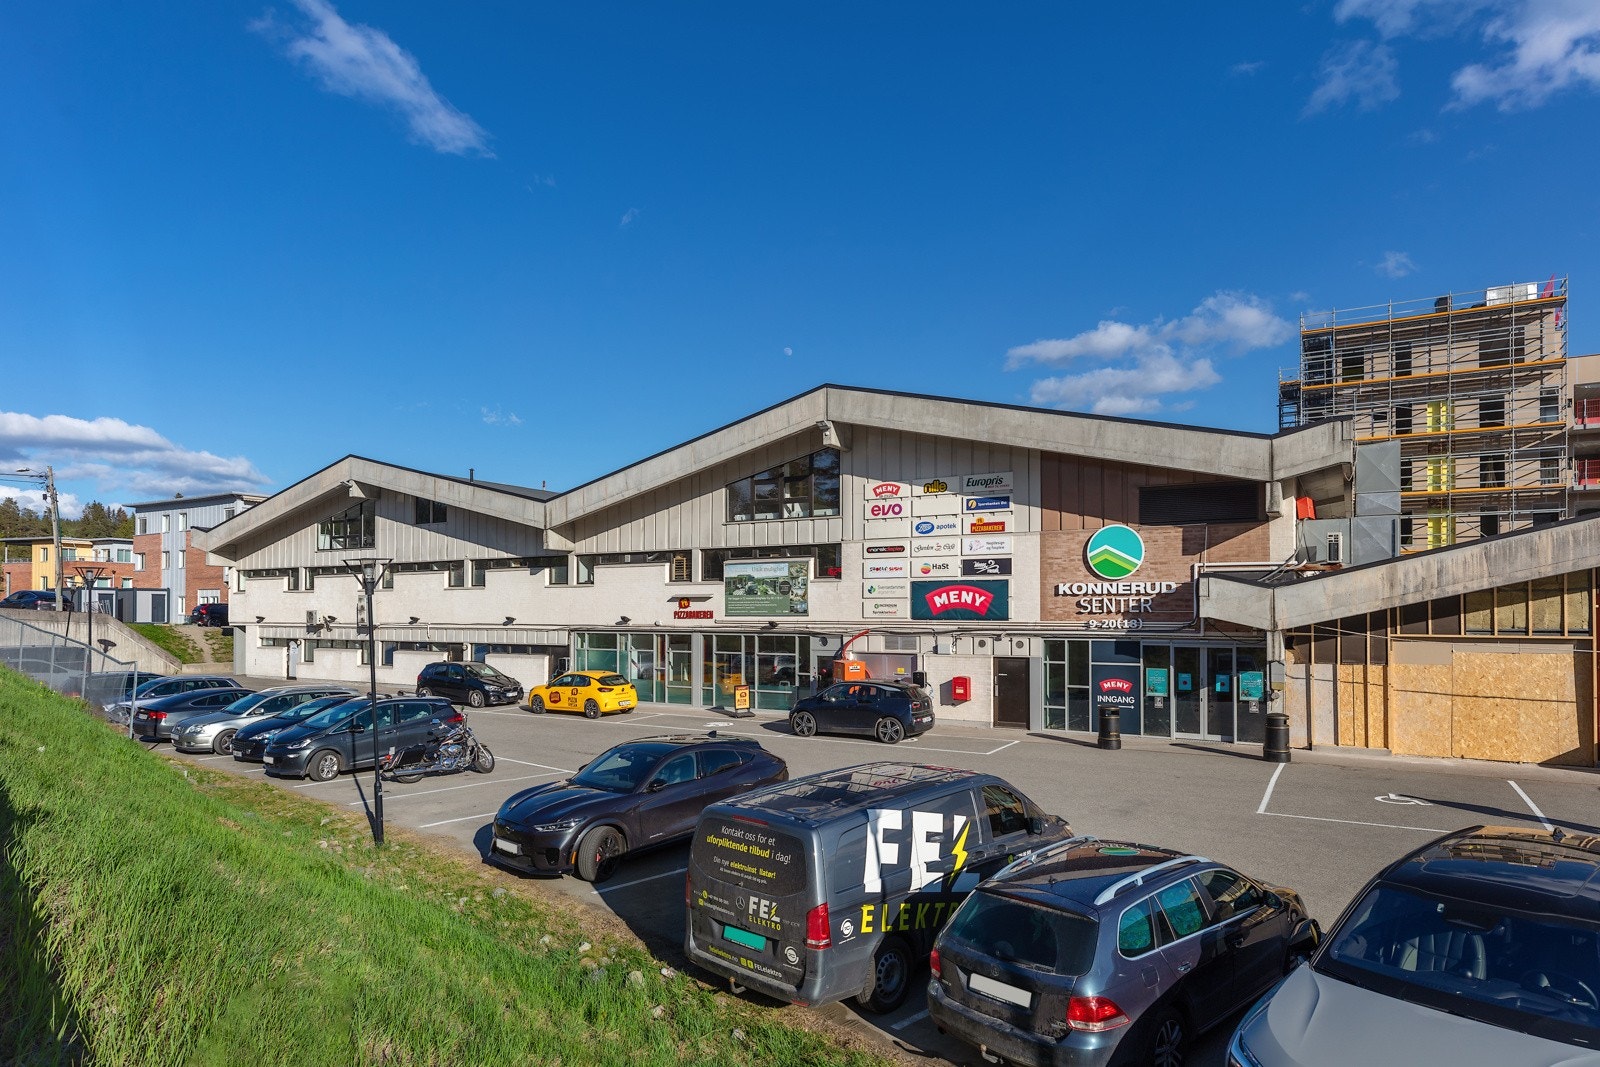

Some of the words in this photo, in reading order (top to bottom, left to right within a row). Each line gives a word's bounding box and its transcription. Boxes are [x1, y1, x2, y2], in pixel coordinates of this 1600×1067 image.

[923, 480, 947, 494] nille
[966, 476, 1003, 488] Europris
[876, 485, 898, 494] MENY
[871, 504, 902, 517] evo
[1058, 581, 1177, 595] KONNERUD
[933, 591, 986, 608] MENY
[1080, 597, 1152, 613] SENTER
[673, 610, 713, 619] PIZZABAKEREN
[1089, 618, 1143, 630] 9-20(18)
[1103, 681, 1129, 689] MENY
[1097, 695, 1135, 704] INNGANG
[722, 825, 744, 839] Kontakt
[745, 832, 756, 841] oss
[757, 833, 767, 844] for
[768, 837, 775, 846] et
[706, 834, 748, 852] uforpliktende
[749, 845, 770, 858] tilbud
[775, 852, 791, 865] dag!
[748, 915, 781, 931] ELEKTRO
